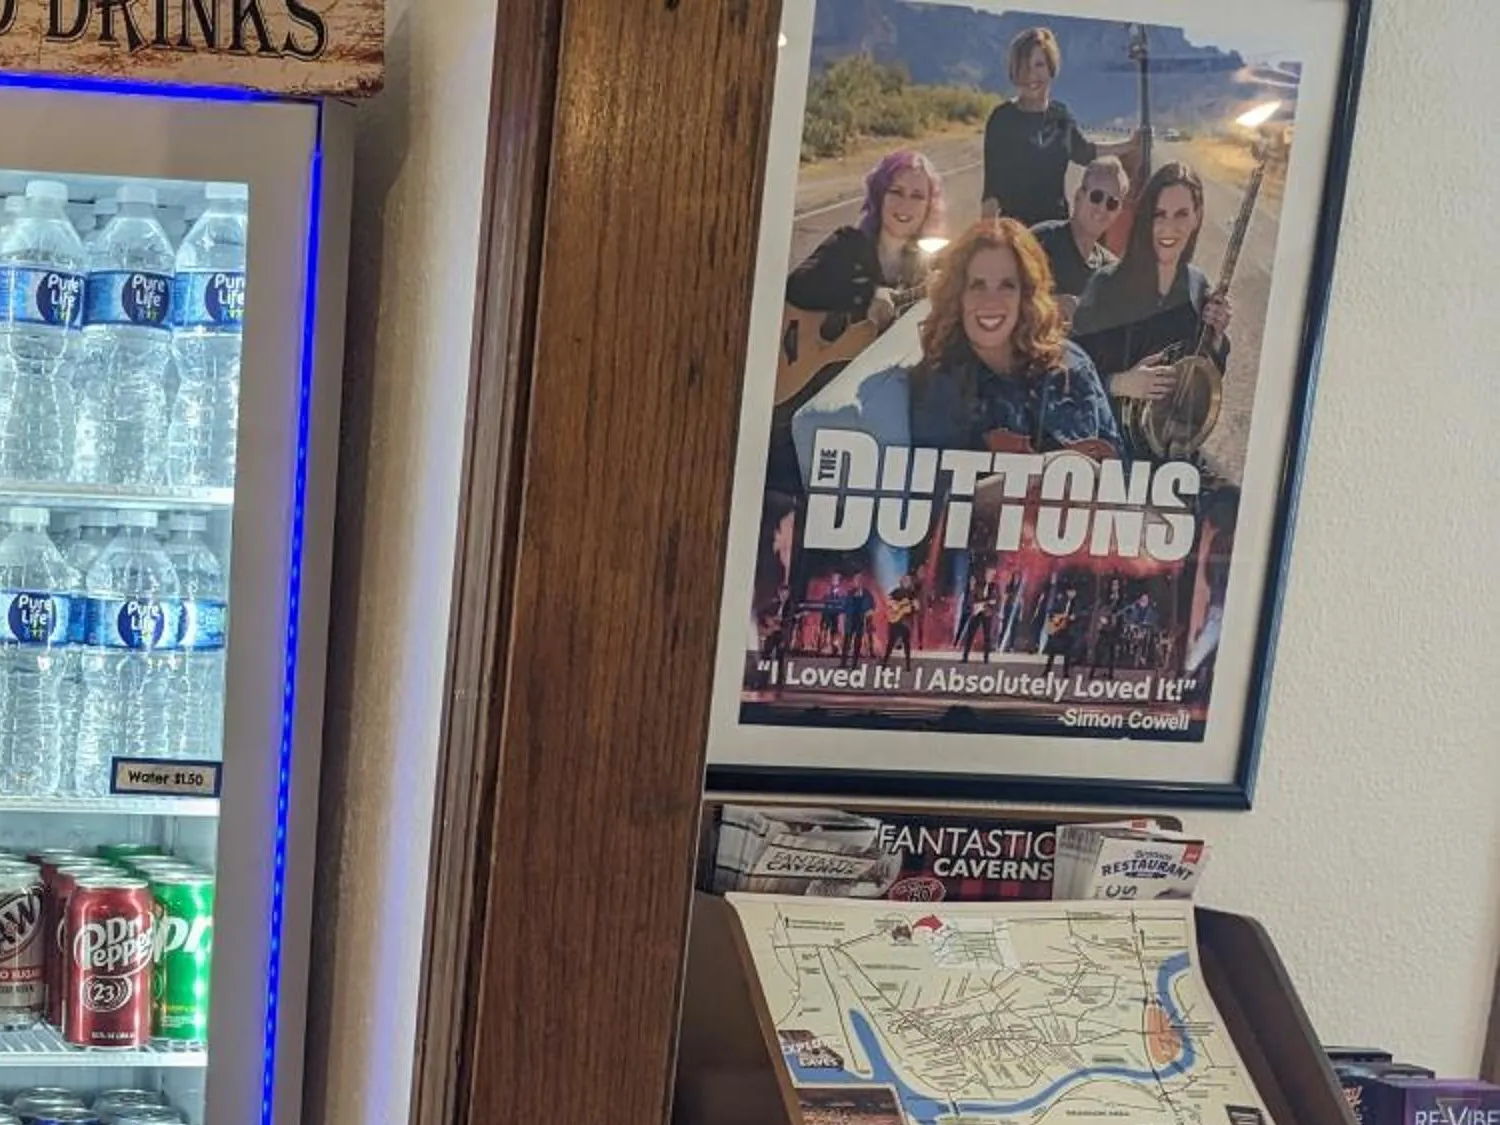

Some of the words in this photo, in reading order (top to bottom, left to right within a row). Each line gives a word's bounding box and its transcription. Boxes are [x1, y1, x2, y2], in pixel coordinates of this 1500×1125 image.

[48, 274, 79, 294] Pure
[132, 274, 164, 293] Pure
[52, 291, 76, 313] Life
[136, 290, 161, 308] Life
[819, 449, 838, 480] THE
[804, 429, 1200, 560] DUTTONS
[19, 594, 52, 612] Pure
[128, 602, 158, 618] Pure
[22, 608, 47, 627] Life
[786, 663, 864, 688] Loved
[873, 665, 900, 689] It!
[914, 668, 924, 690] I
[928, 668, 1068, 701] Absolutely
[1075, 673, 1151, 699] Loved
[1129, 711, 1190, 731] Cowell
[128, 770, 169, 785] Water
[880, 824, 1057, 860] FANTASTIC
[933, 857, 1054, 881] CAVERNS
[1101, 858, 1193, 881] RESTAURANT
[106, 918, 142, 943] Dr
[93, 983, 114, 1002] 23
